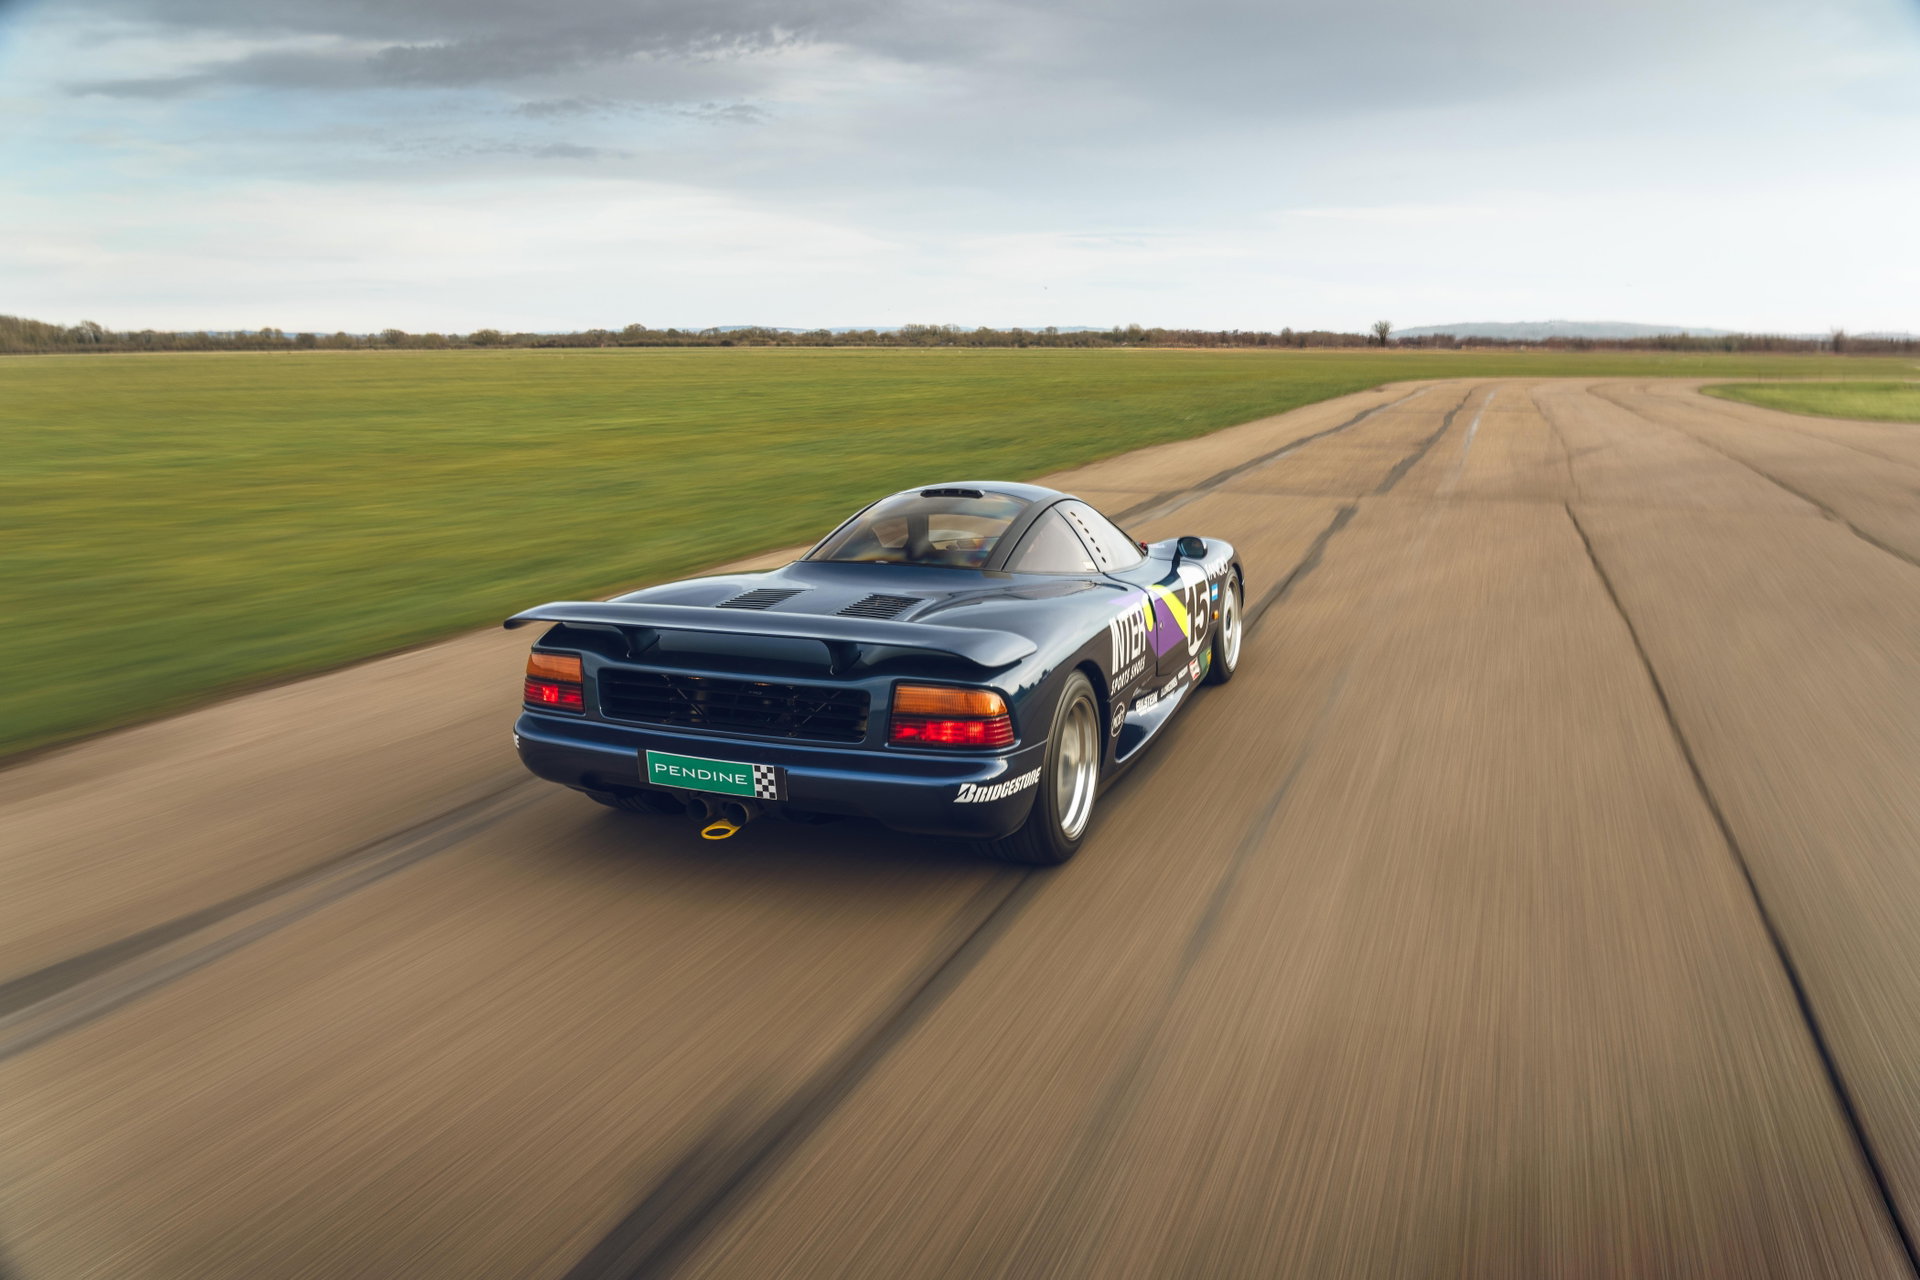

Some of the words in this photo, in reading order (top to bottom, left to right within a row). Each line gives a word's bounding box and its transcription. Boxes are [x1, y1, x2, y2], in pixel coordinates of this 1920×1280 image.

[1187, 581, 1208, 645] 15
[1109, 601, 1146, 675] INTER
[1110, 667, 1131, 696] SPORTS
[1130, 655, 1146, 681] SHOES
[655, 763, 748, 785] PENDINE
[953, 766, 1042, 803] BRIDGESTONE
